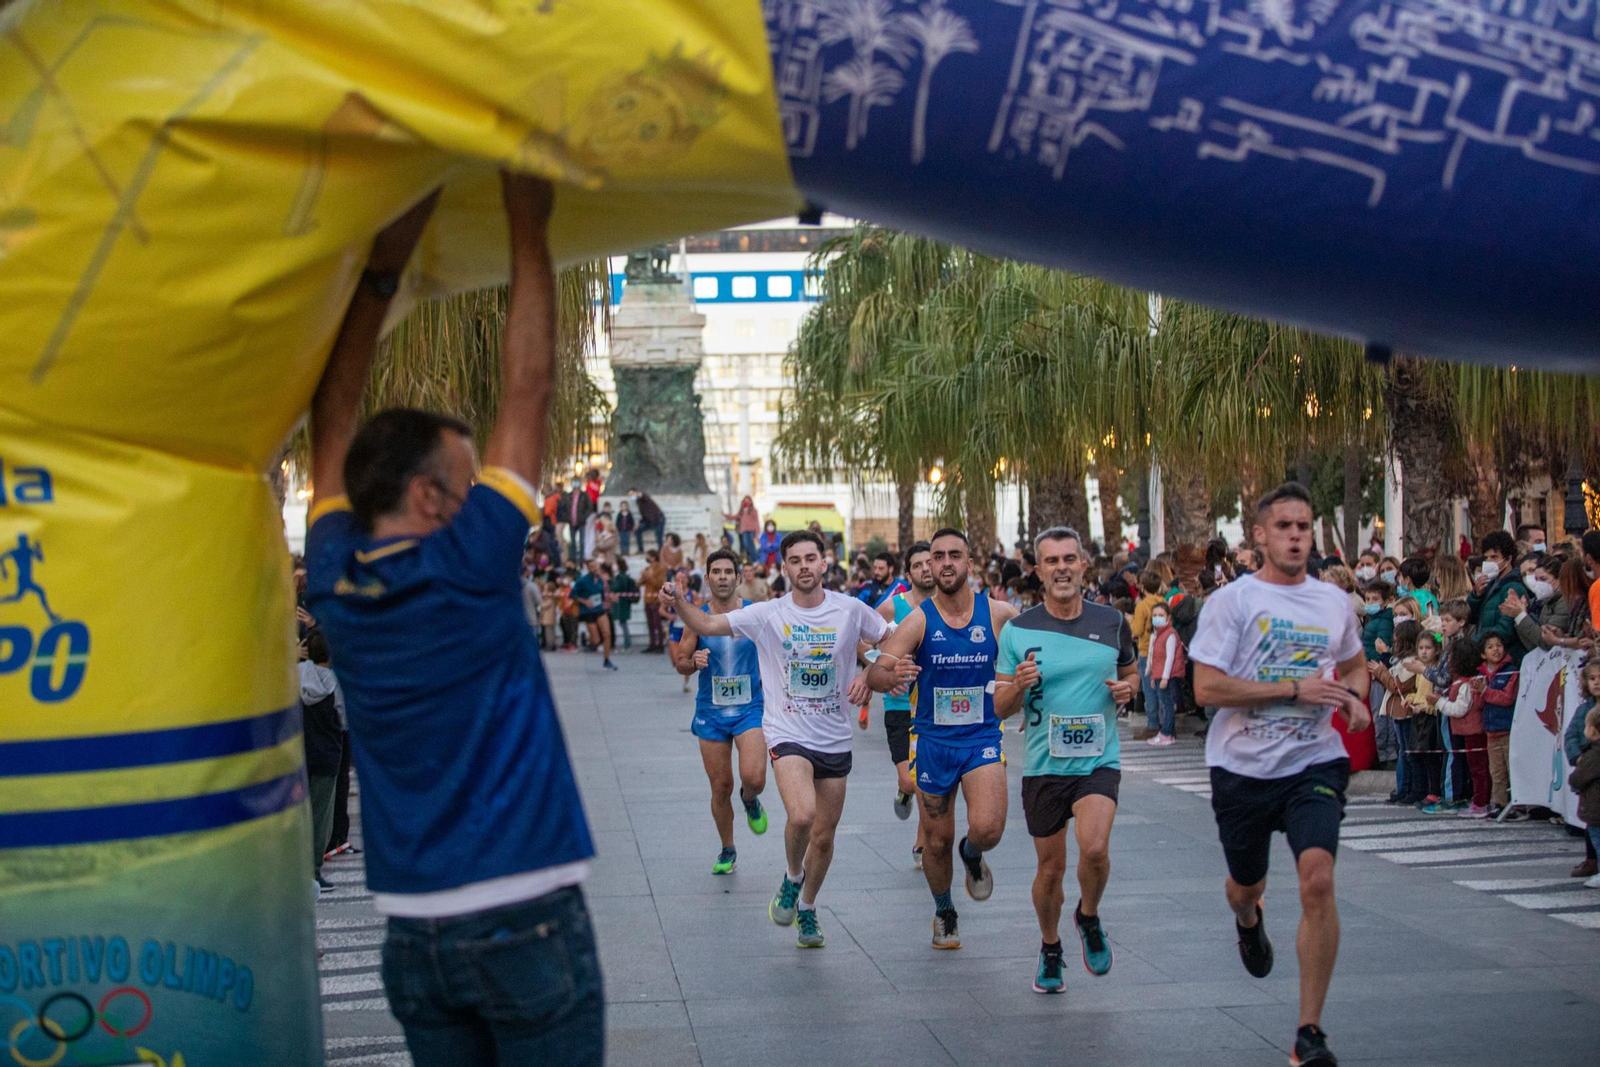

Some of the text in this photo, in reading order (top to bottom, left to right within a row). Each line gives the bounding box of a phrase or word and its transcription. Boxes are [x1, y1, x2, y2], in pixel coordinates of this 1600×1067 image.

[792, 624, 809, 633] SAN
[1271, 617, 1294, 630] SAN
[792, 633, 837, 642] SILVESTRE
[931, 652, 988, 665] Tirabuzón
[801, 672, 828, 686] 990
[721, 685, 742, 697] 211
[951, 699, 971, 714] 59
[1062, 729, 1094, 745] 562
[140, 939, 255, 1013] OLIMPO
